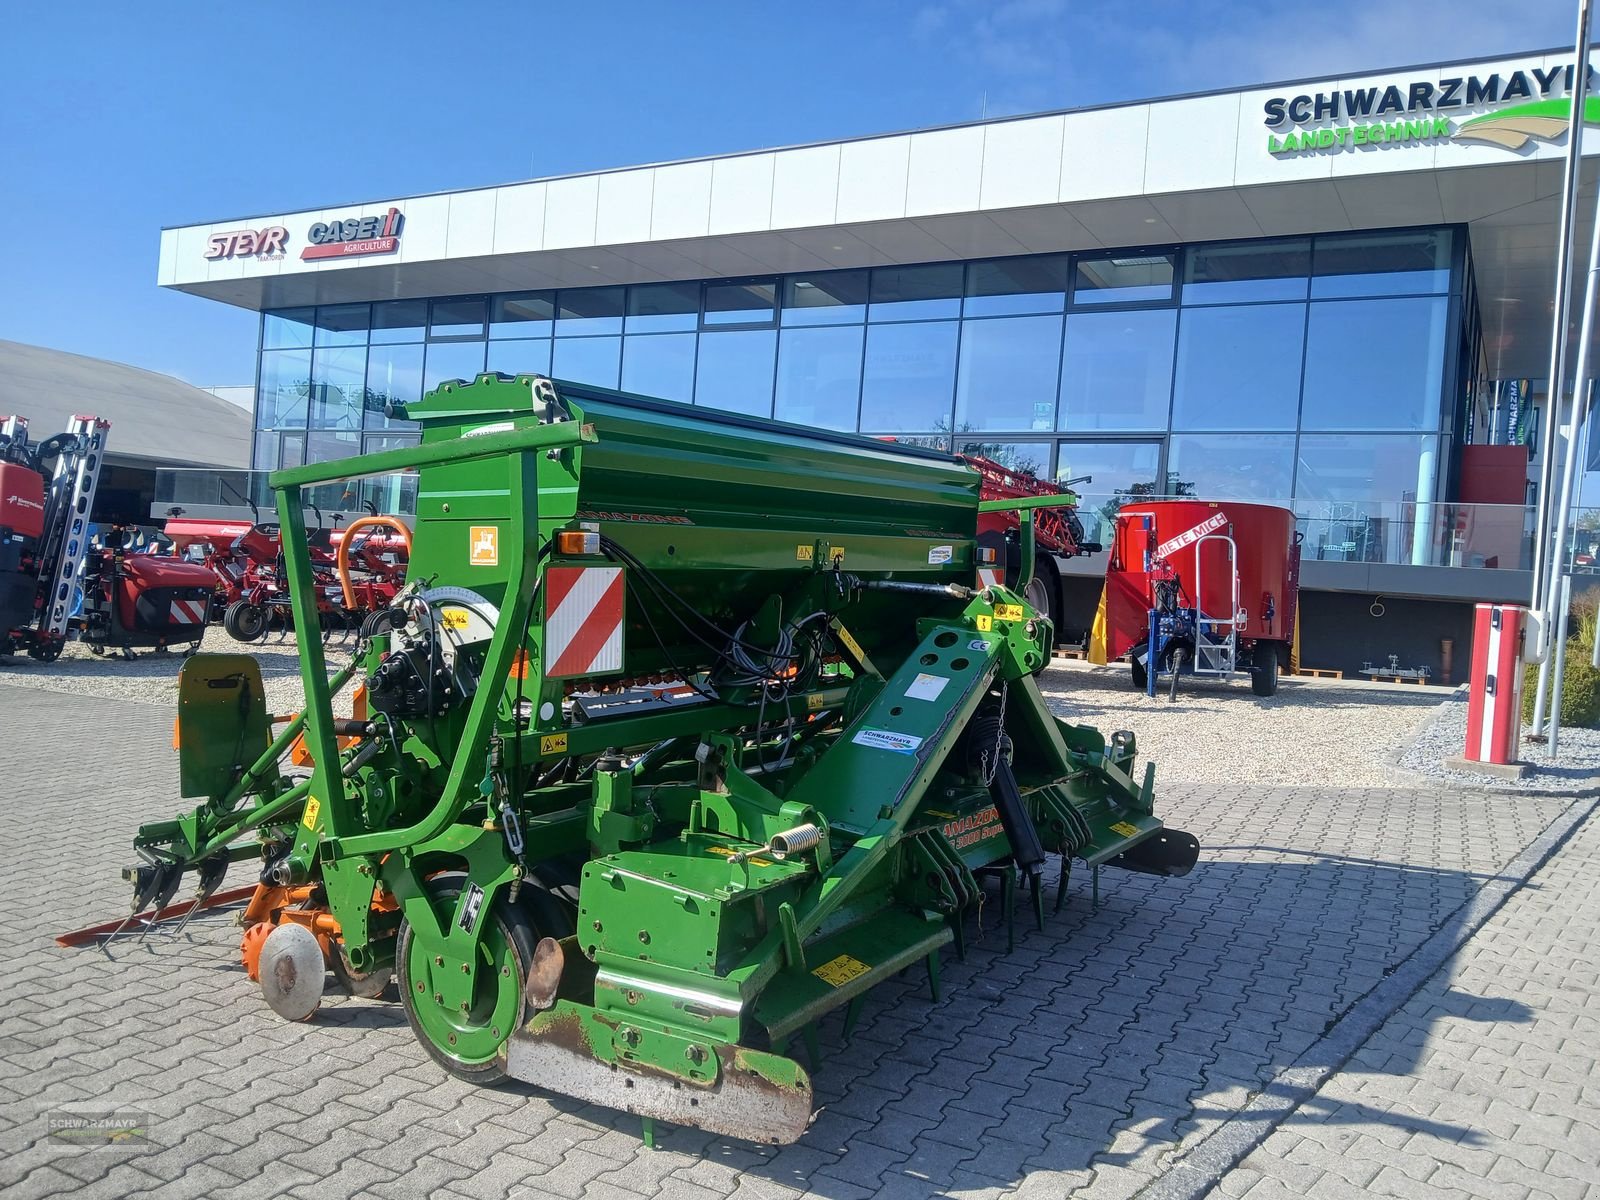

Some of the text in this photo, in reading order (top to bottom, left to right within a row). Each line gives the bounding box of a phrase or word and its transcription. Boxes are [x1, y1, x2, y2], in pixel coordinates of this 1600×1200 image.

[1264, 64, 1594, 126] SCHWARZMAYR
[1268, 117, 1450, 154] LANDTECHNIK
[204, 226, 287, 259] STEYR
[344, 239, 392, 254] AGRICULTURE
[1158, 513, 1227, 557] MIETE MICH
[864, 731, 911, 744] SCHWARZMAYR
[943, 807, 1000, 838] AMAZON
